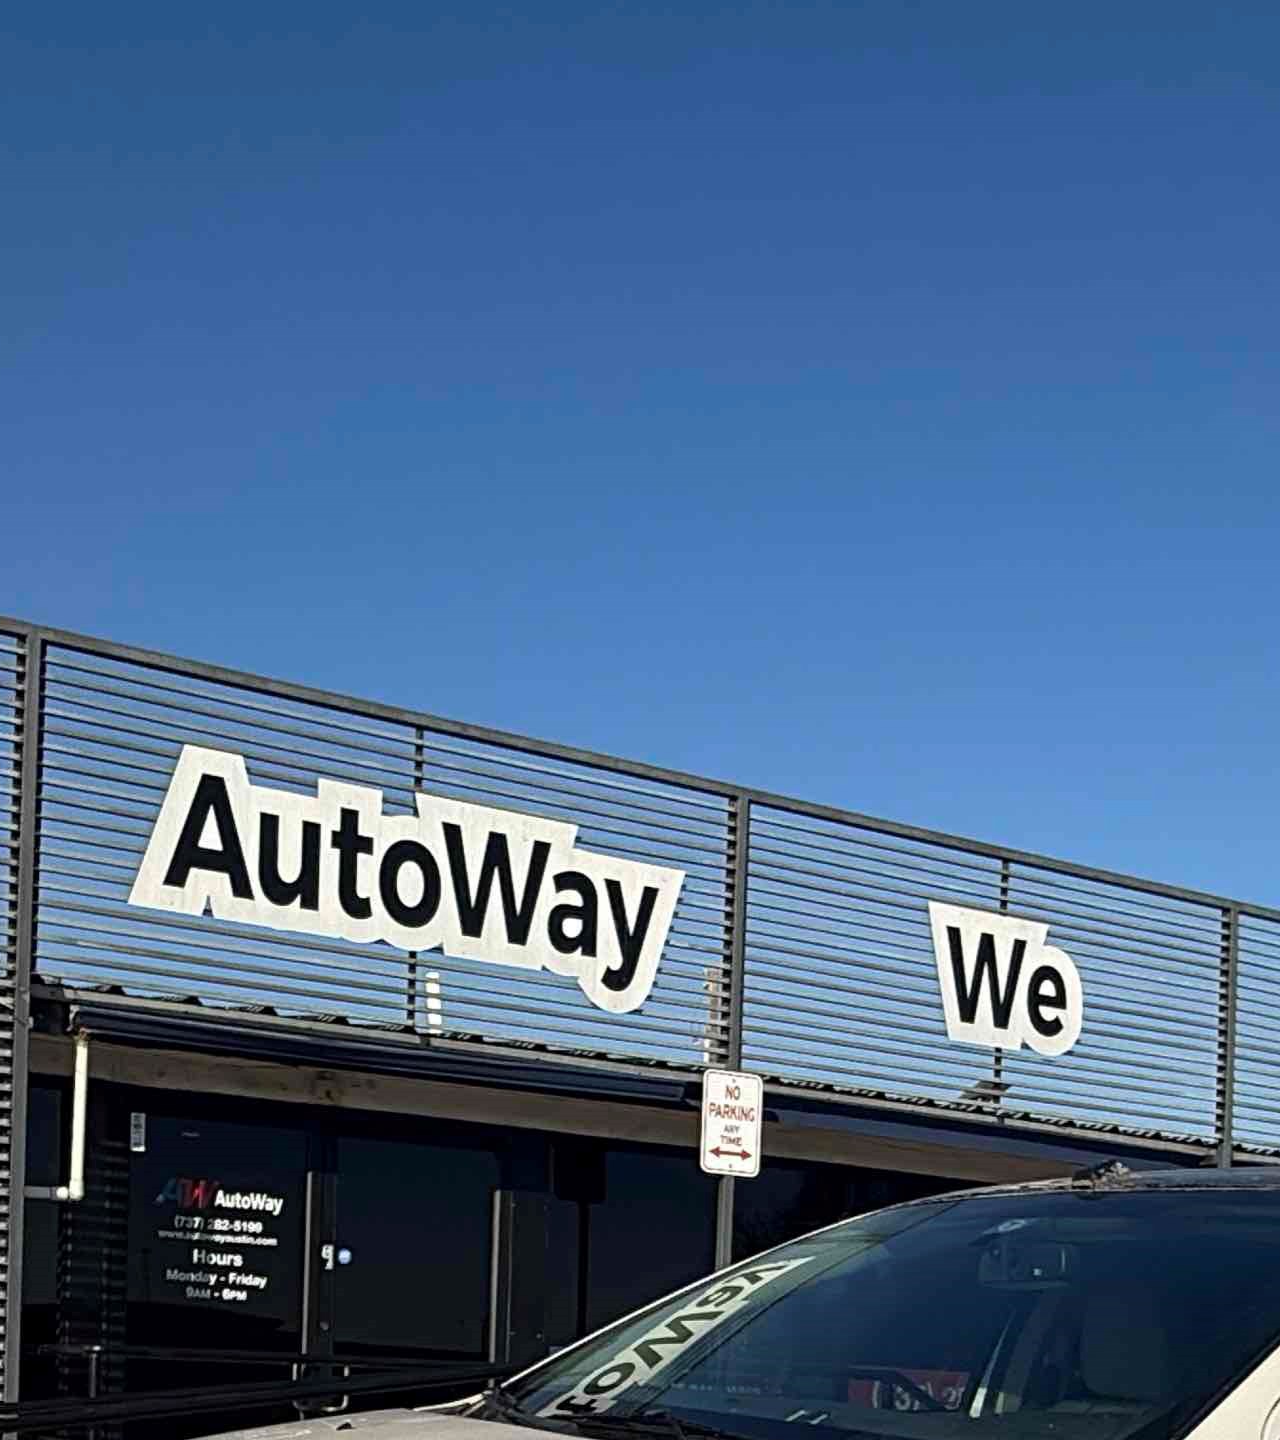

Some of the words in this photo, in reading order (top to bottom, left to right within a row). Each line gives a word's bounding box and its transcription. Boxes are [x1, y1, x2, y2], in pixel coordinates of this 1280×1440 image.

[162, 774, 659, 992] AutoWay
[946, 925, 1068, 1037] We
[724, 1085, 741, 1101] NO
[709, 1102, 755, 1122] PARKING
[723, 1124, 740, 1134] ANY
[720, 1135, 742, 1146] TIME
[214, 1189, 284, 1216] AutoWay
[174, 1215, 204, 1229] (737)
[207, 1217, 263, 1234] 282-5199
[192, 1248, 243, 1267] Hours
[166, 1268, 218, 1286] Monday
[228, 1271, 268, 1289] Friday
